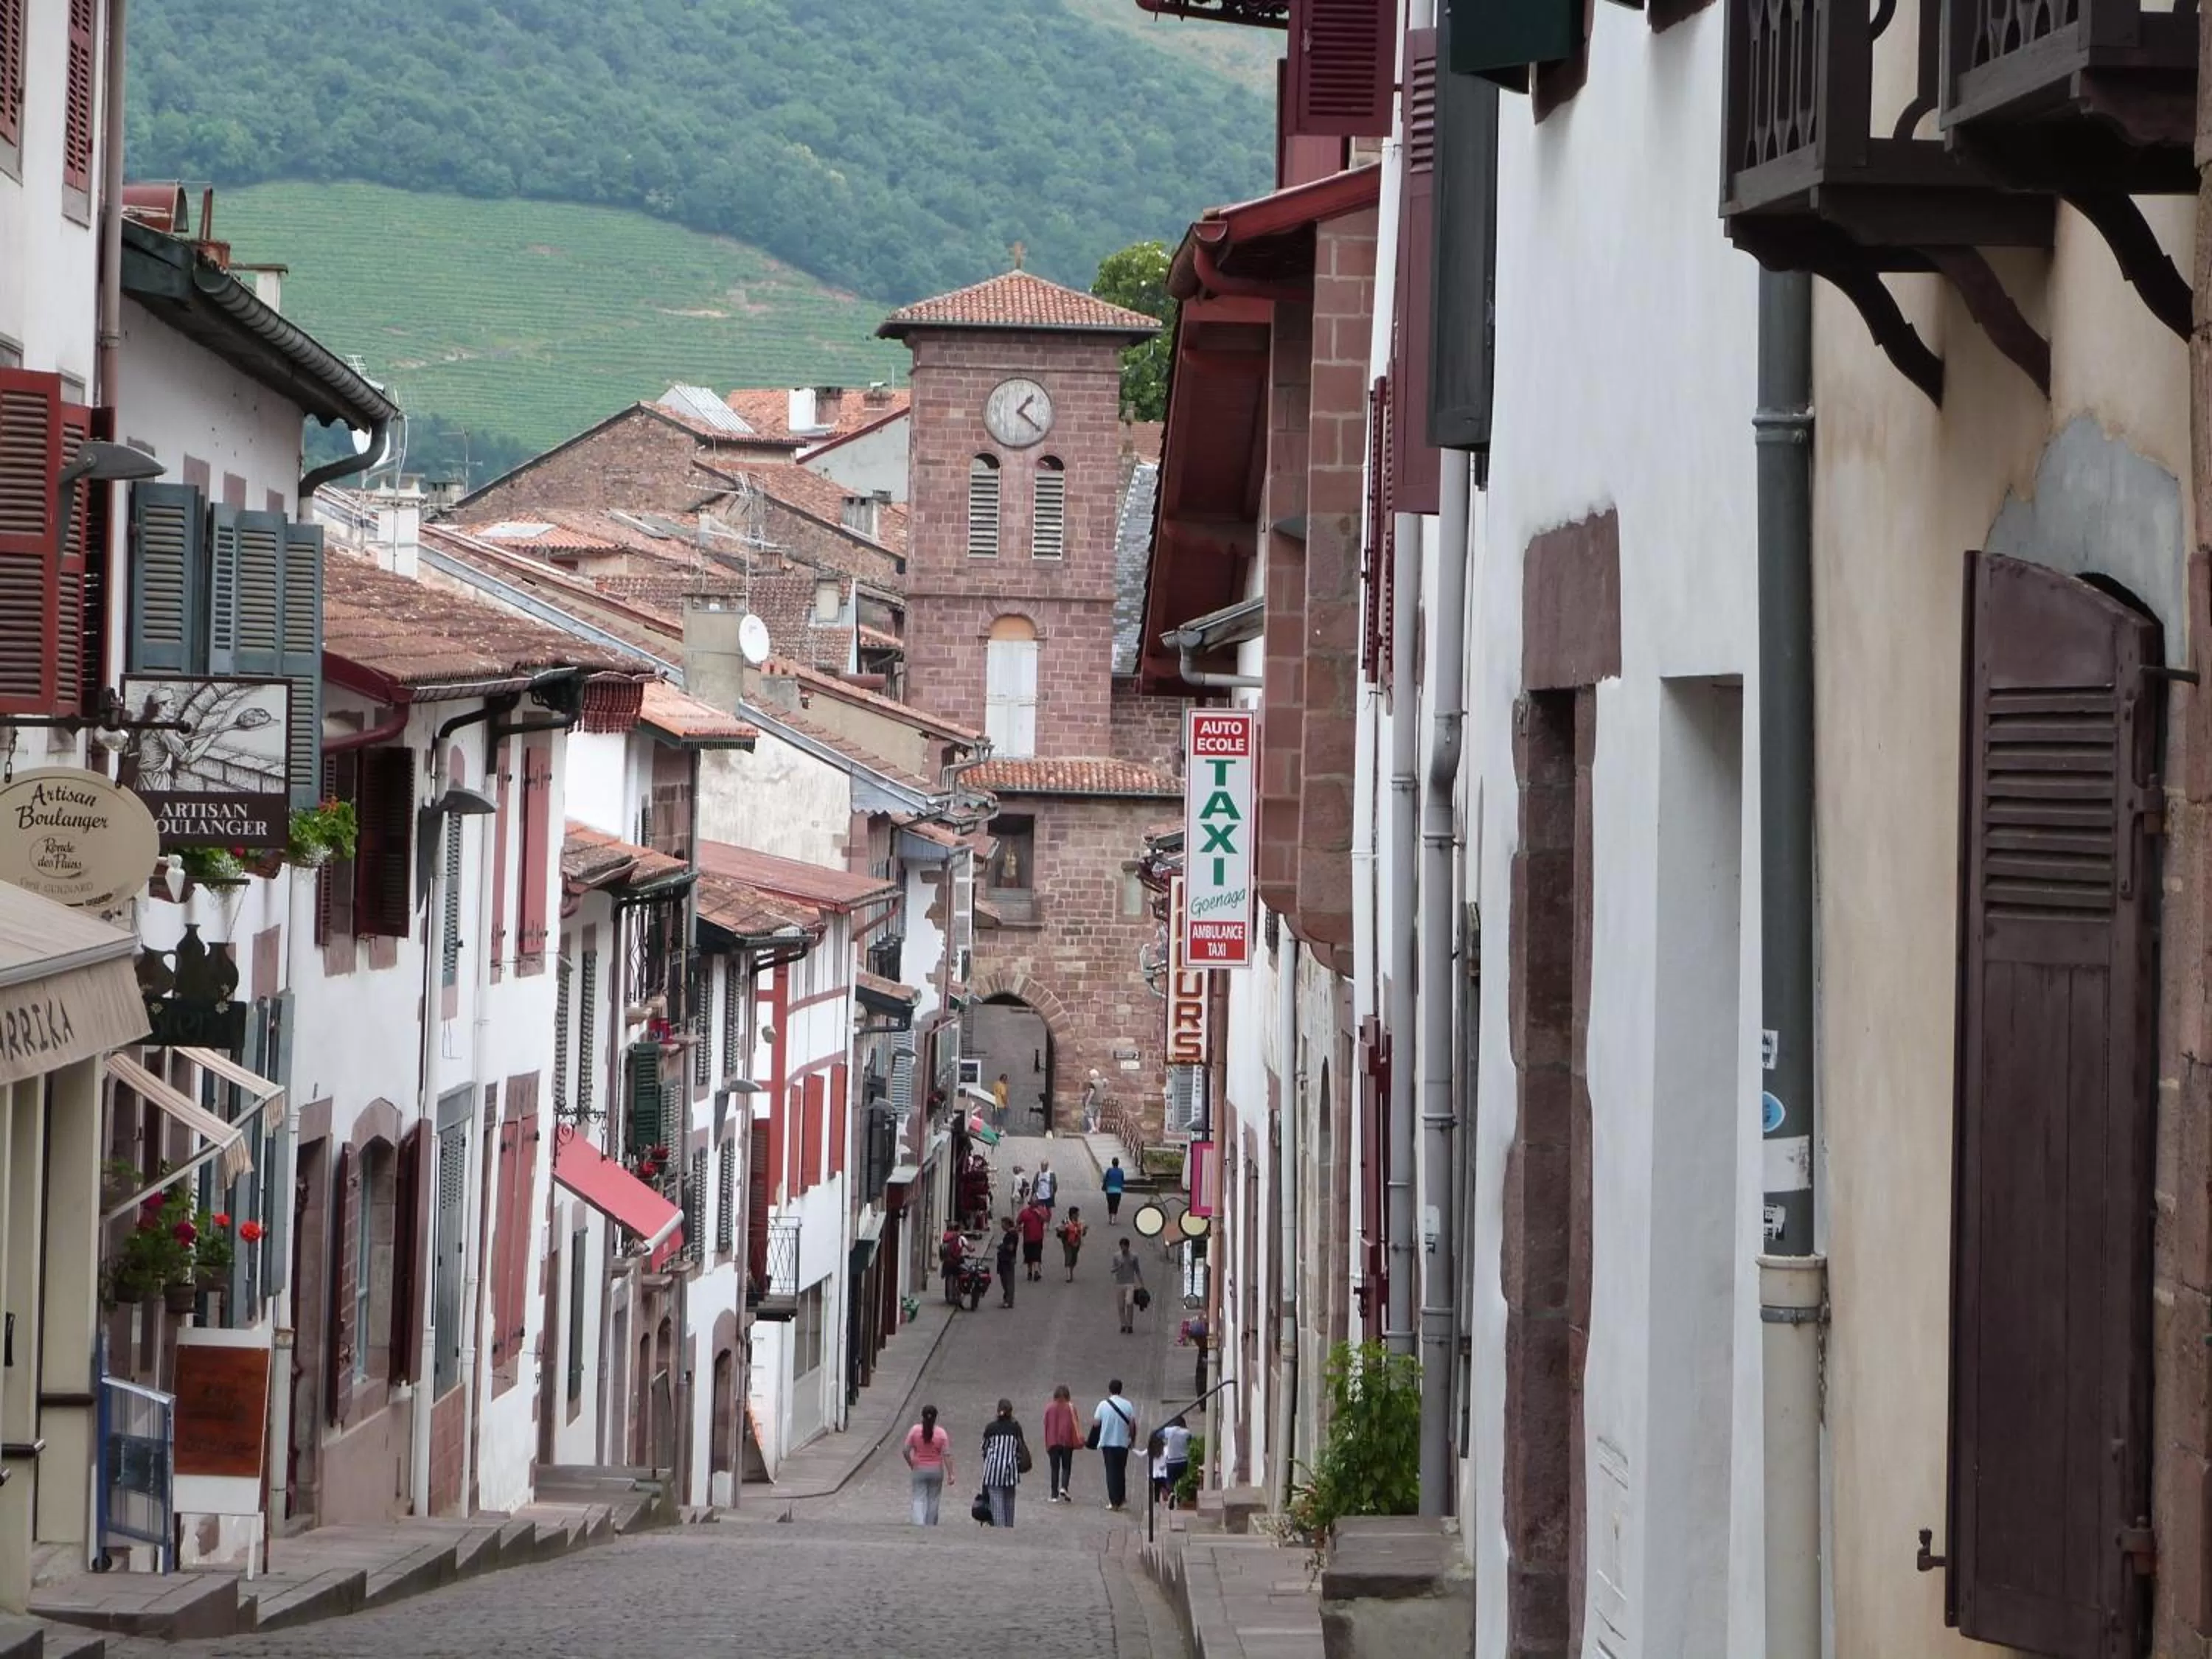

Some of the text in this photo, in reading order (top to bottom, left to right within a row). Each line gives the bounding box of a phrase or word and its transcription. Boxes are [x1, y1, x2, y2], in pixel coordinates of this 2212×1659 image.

[1200, 721, 1242, 734] AUTO
[1197, 738, 1245, 752] ECOLE
[31, 783, 97, 807] Artisan
[159, 801, 248, 818] ARTISAN
[15, 805, 109, 833] Boulanger
[154, 818, 268, 835] OULANGER
[1199, 759, 1241, 886] TAXI
[1190, 888, 1246, 918] Goenaga
[1192, 925, 1243, 939] AMBULANCE
[1207, 942, 1227, 956] TAXI
